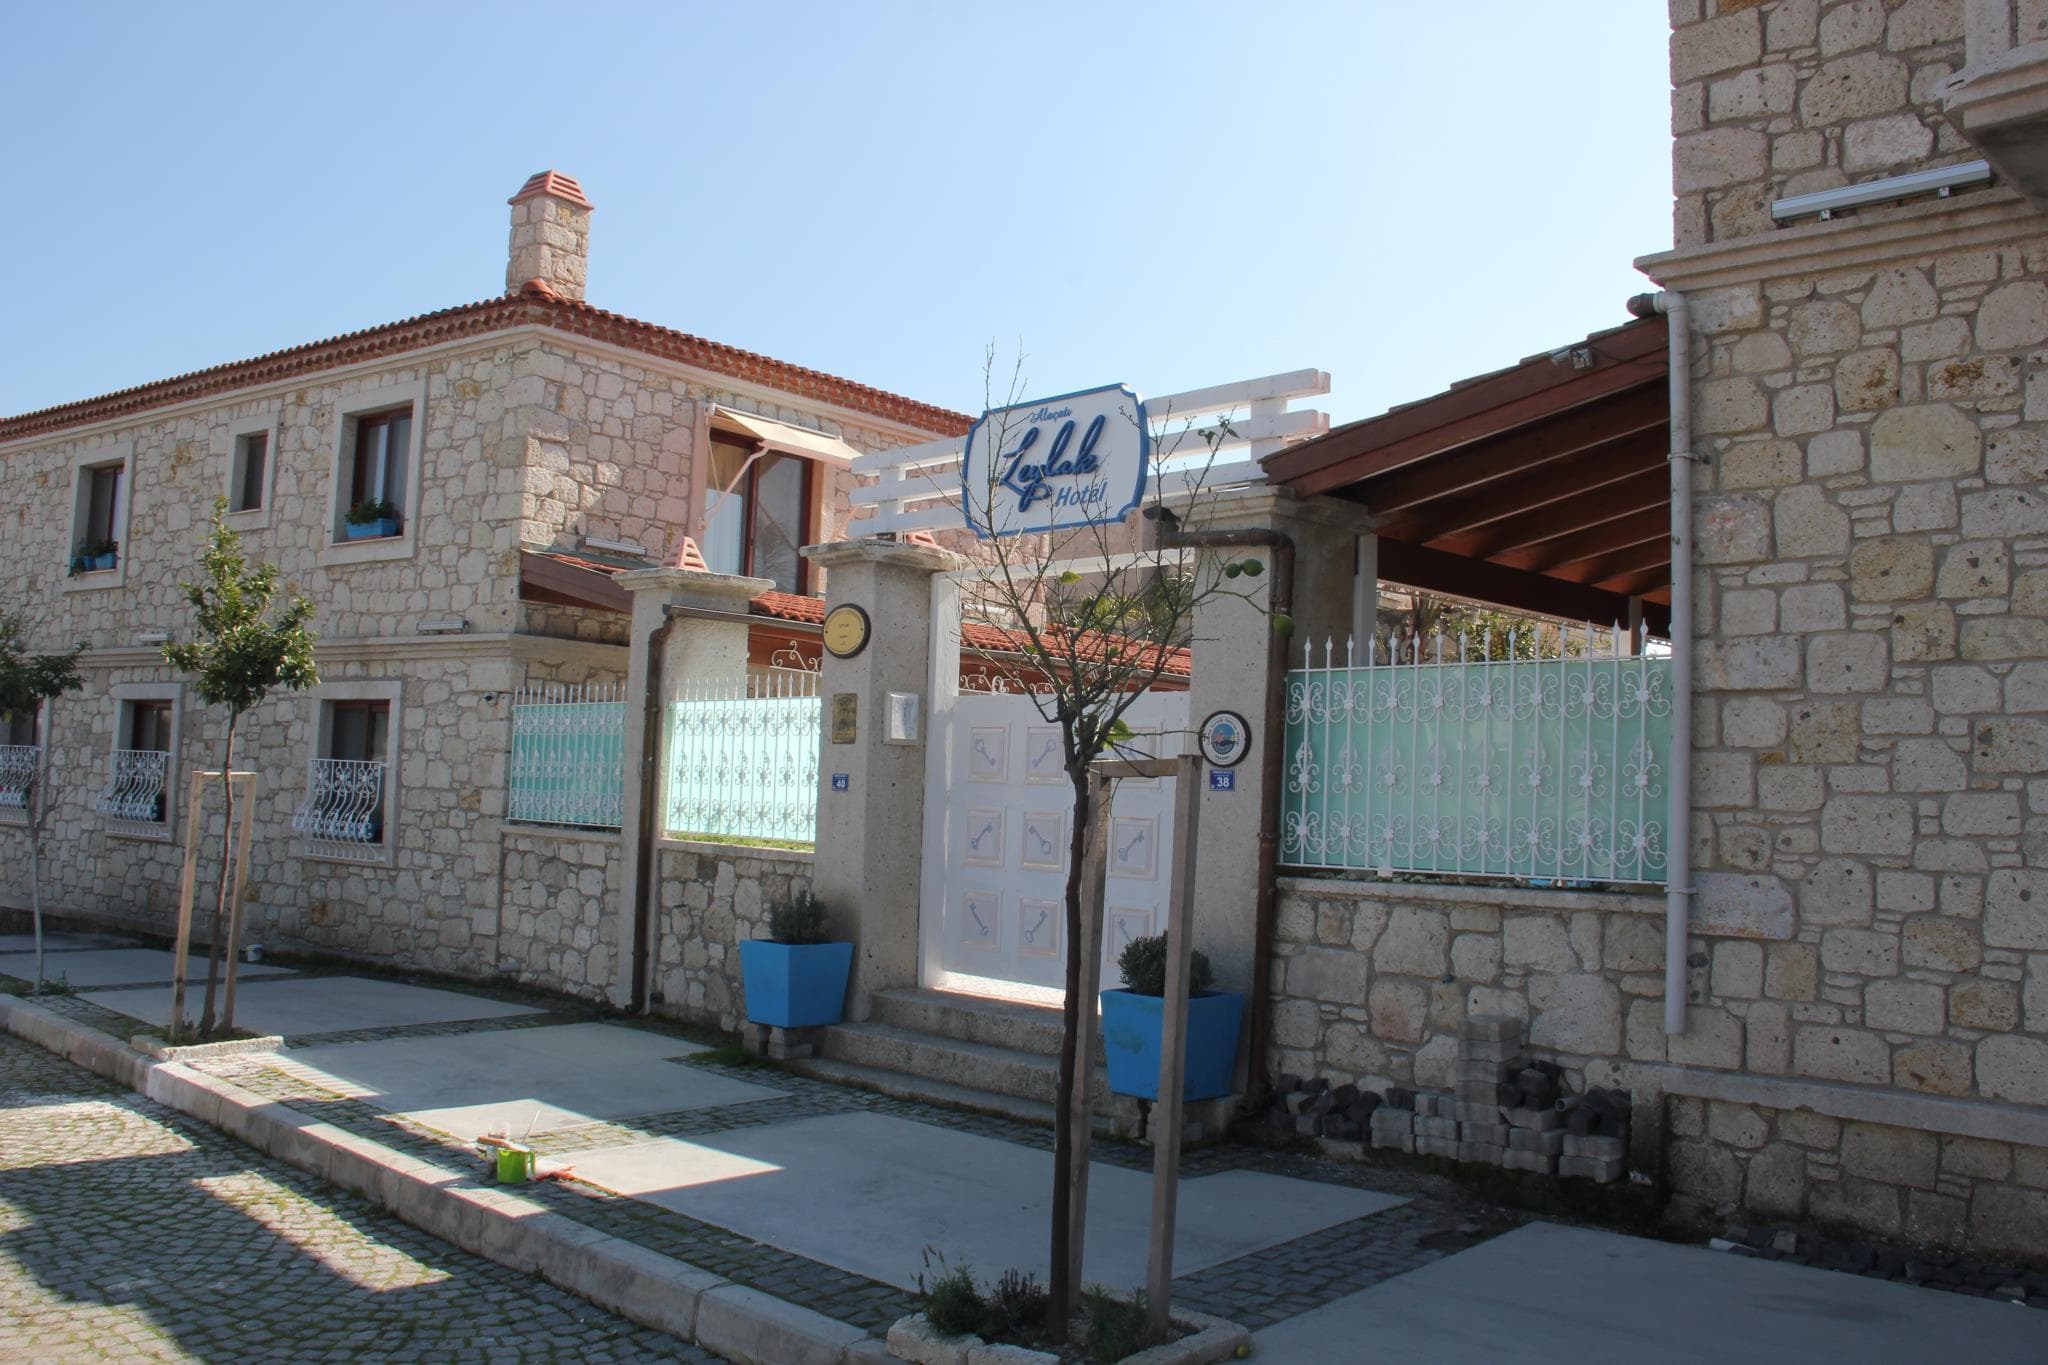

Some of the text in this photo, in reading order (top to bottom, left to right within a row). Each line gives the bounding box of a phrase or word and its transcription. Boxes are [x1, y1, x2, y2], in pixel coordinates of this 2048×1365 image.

[1000, 414, 1106, 513] Leylak
[1054, 481, 1108, 508] Hotel
[836, 779, 846, 788] 40
[1216, 776, 1230, 788] 38
